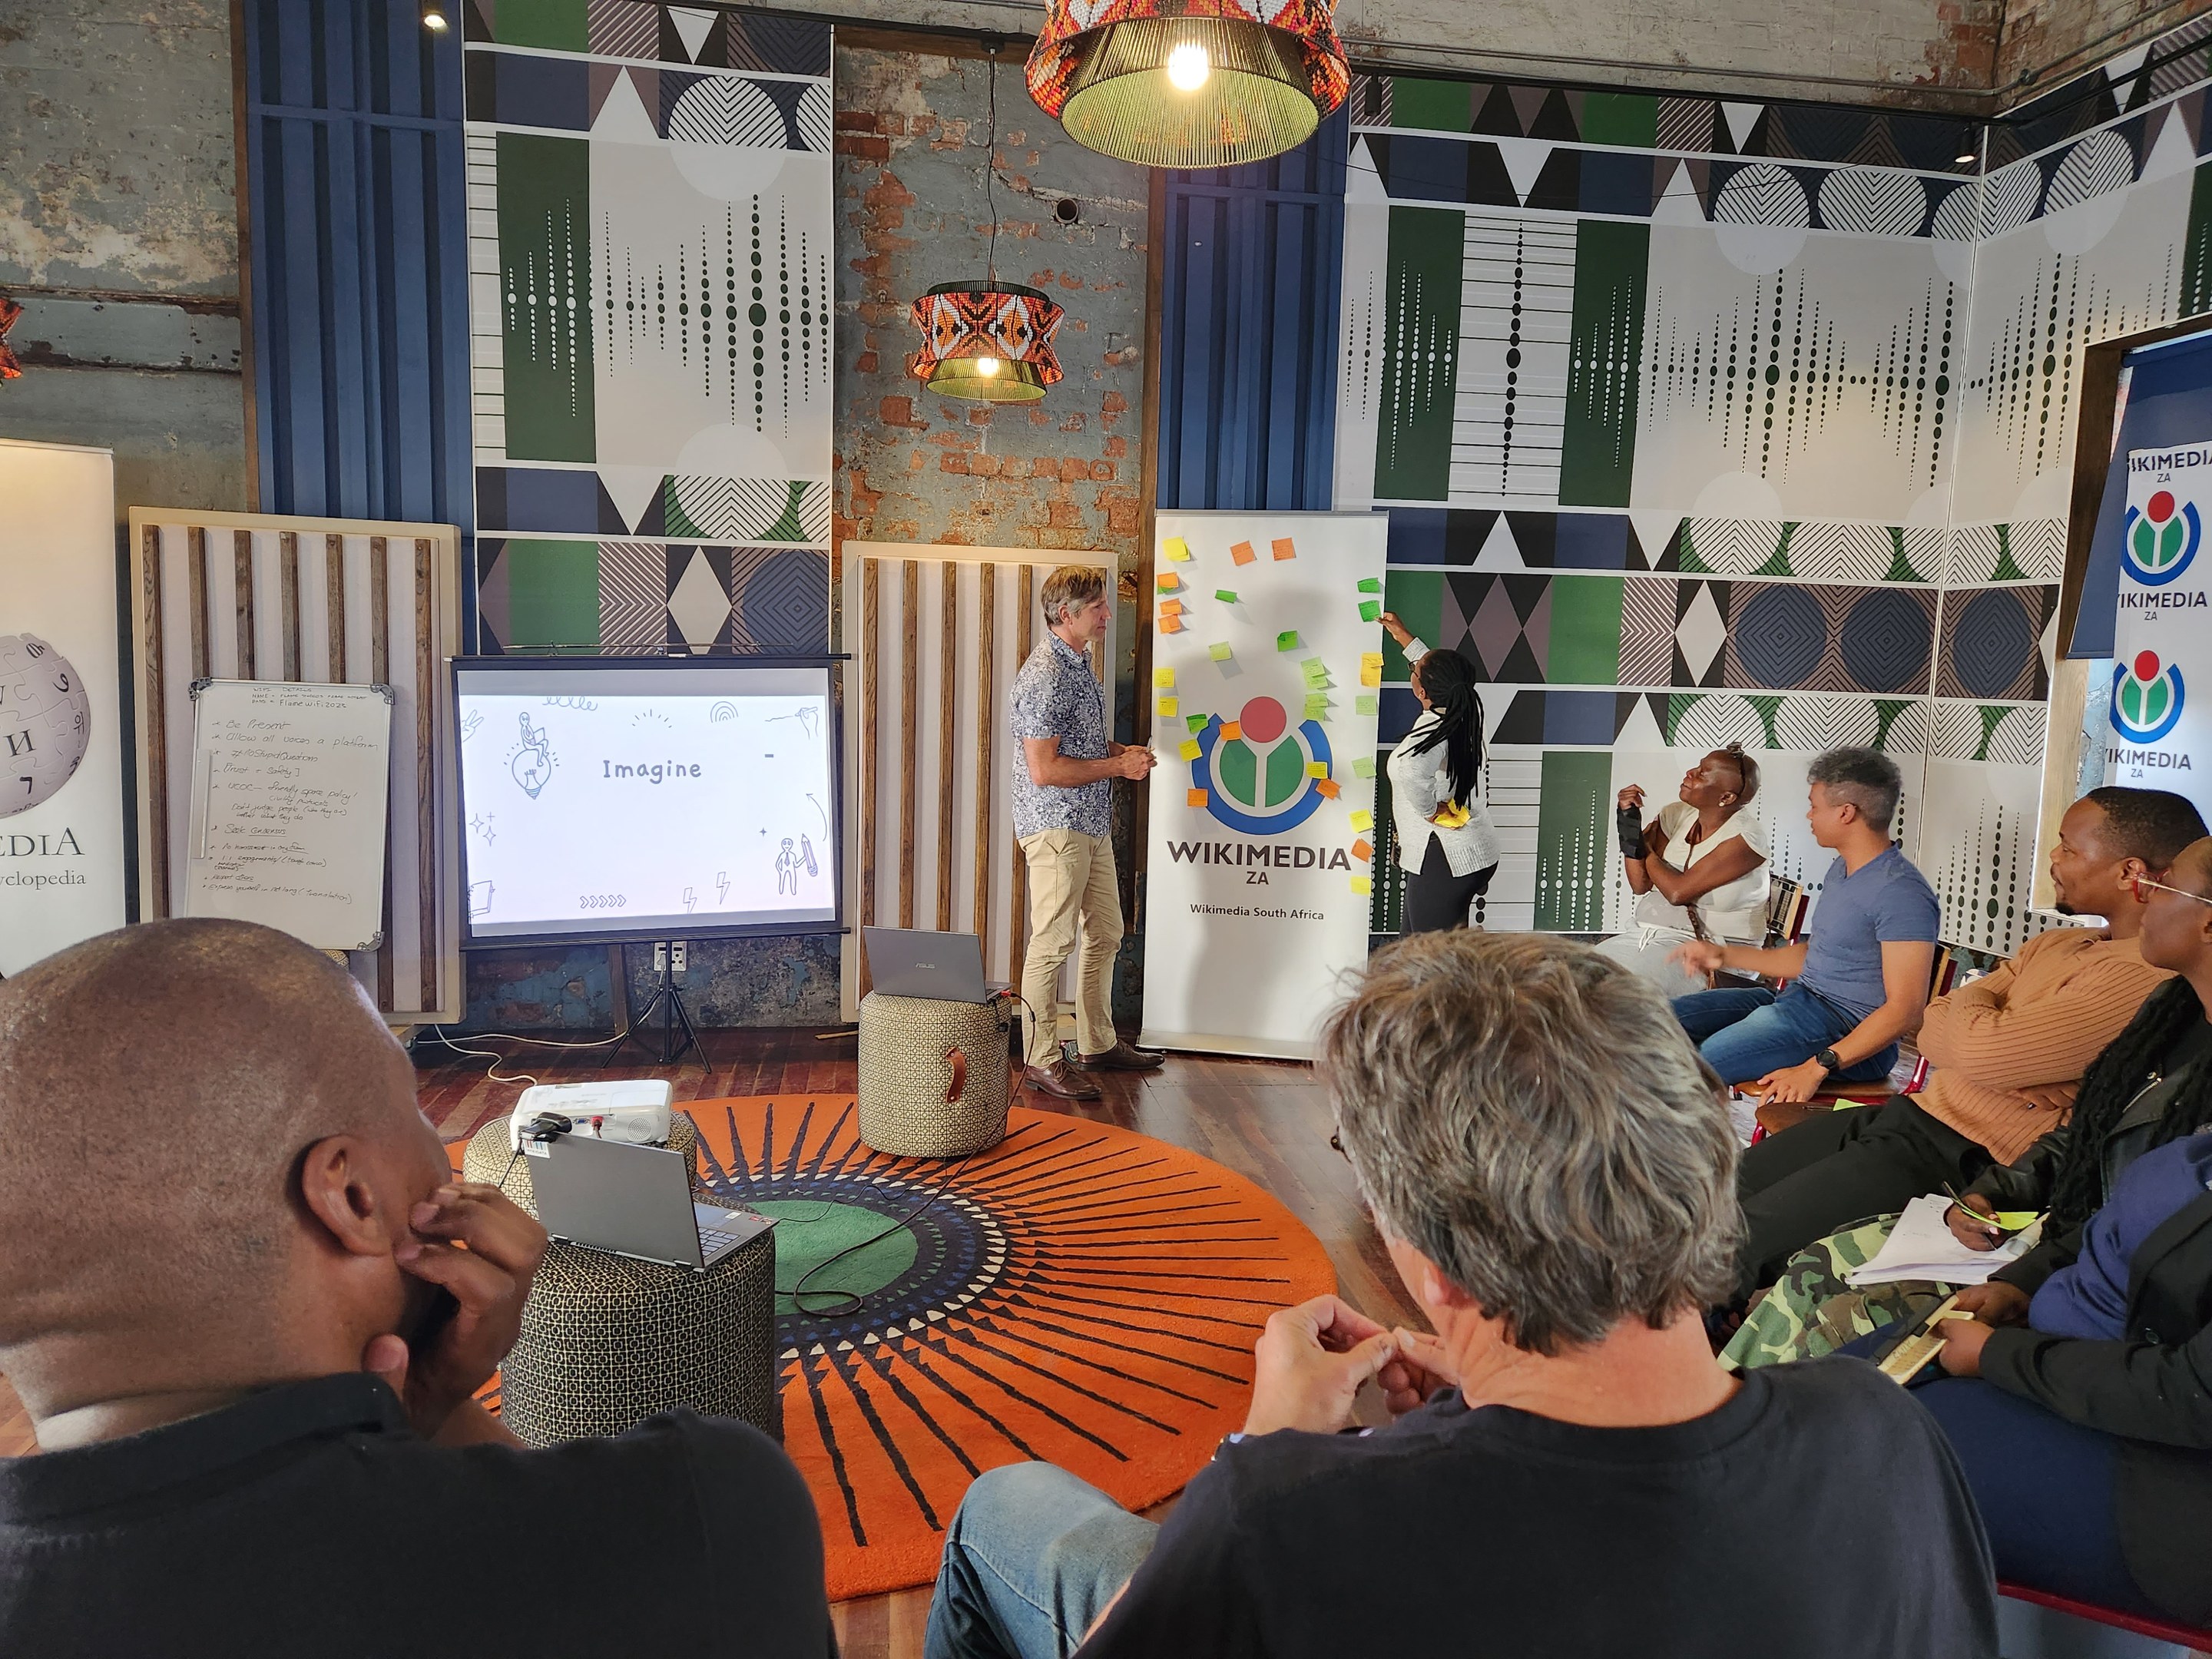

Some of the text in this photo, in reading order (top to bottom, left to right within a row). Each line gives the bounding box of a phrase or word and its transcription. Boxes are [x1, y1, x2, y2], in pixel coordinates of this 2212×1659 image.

[2127, 449, 2212, 472] IKIMEDI
[2157, 473, 2171, 483] ZA
[2118, 591, 2207, 608] IKIMEDIA
[2144, 611, 2157, 621] ZA
[226, 720, 241, 729] Be
[262, 734, 275, 743] all
[332, 735, 378, 751] platform
[2105, 748, 2191, 770] IKIMEDIA
[603, 760, 702, 784] Imagine
[2131, 768, 2143, 778] ZA
[1167, 841, 1352, 871] WIKIMEDIA
[1247, 871, 1269, 885] ZA
[1190, 904, 1324, 920] Wikimedia South Africa
